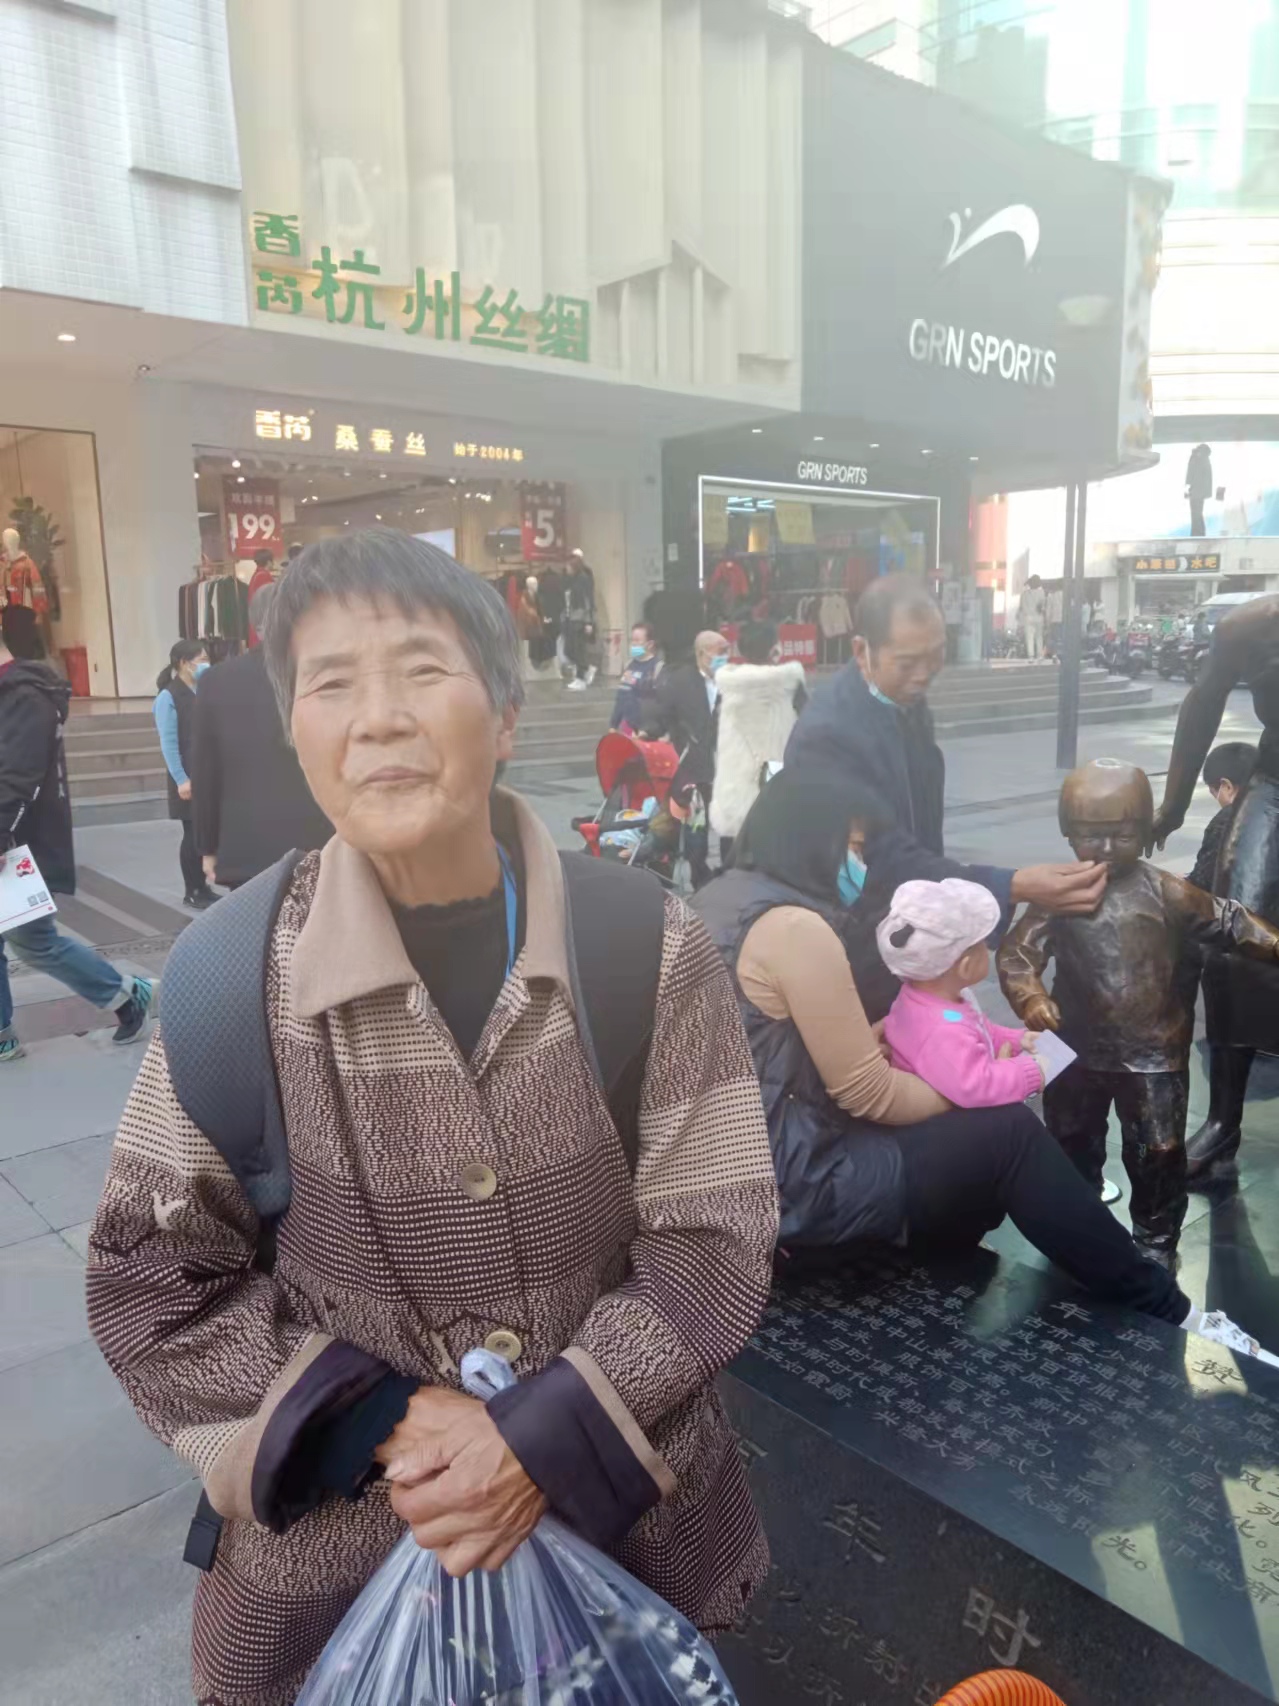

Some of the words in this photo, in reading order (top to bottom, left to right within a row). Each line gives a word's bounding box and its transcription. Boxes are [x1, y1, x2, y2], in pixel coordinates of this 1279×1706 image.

[908, 318, 965, 369] GRN
[967, 330, 1058, 389] SPORTS
[797, 460, 823, 481] GRN
[824, 463, 869, 486] SPORTS
